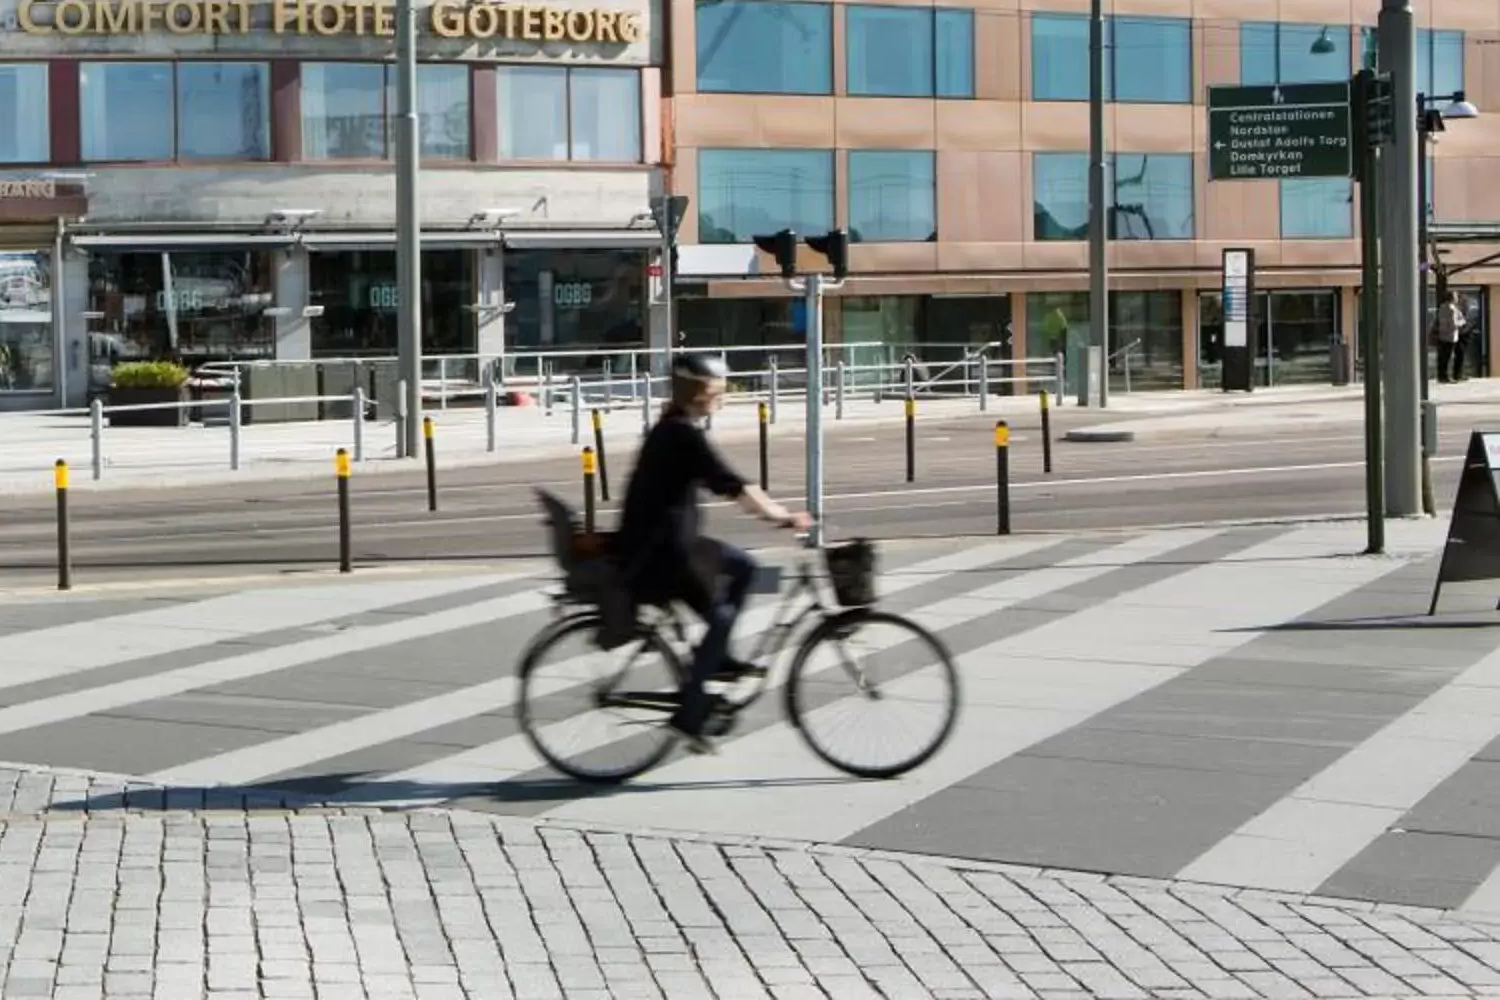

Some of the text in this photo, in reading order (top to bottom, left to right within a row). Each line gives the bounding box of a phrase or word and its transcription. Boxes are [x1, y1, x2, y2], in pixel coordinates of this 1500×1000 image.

[1230, 110, 1335, 124] Centralstationen
[1319, 135, 1347, 148] Torg
[1230, 150, 1303, 163] Domkyrkan
[1260, 163, 1301, 176] Torget
